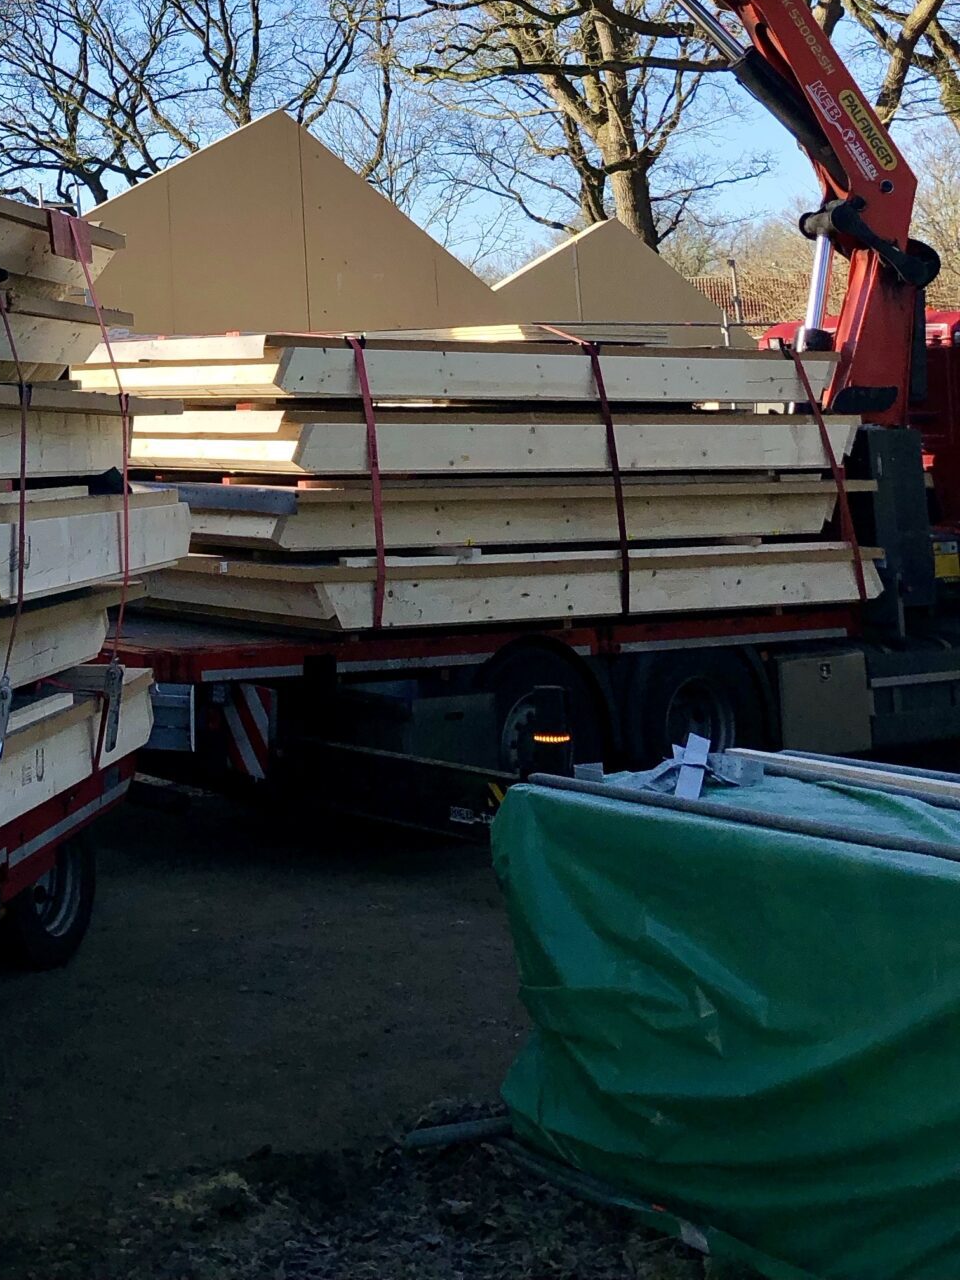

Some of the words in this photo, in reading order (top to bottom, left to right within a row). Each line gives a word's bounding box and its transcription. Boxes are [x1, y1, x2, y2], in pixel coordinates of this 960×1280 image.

[809, 79, 842, 121] KFB
[841, 93, 894, 167] PALFINGER
[851, 141, 879, 178] JESSEN
